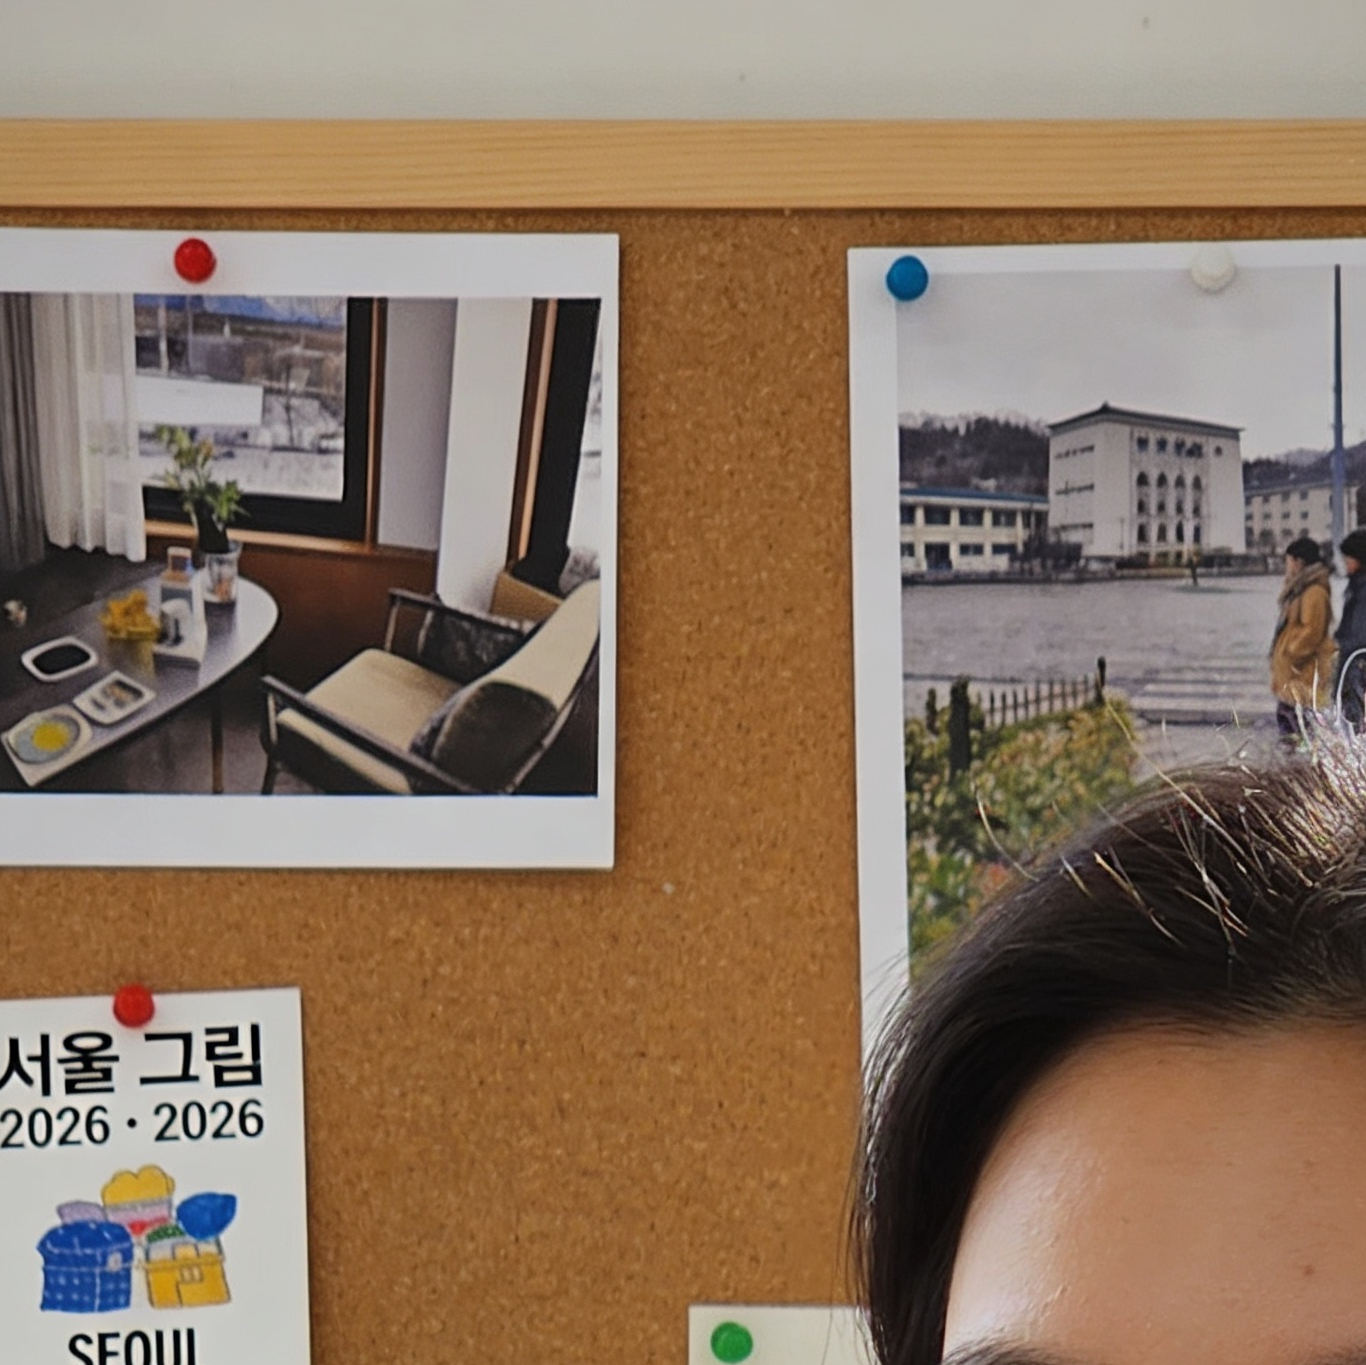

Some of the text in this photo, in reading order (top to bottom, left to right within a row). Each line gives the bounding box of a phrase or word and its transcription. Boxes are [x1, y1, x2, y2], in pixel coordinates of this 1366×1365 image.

[139, 1023, 264, 1089] 그림
[0, 1105, 110, 1149] 2026
[154, 1098, 265, 1142] 2026
